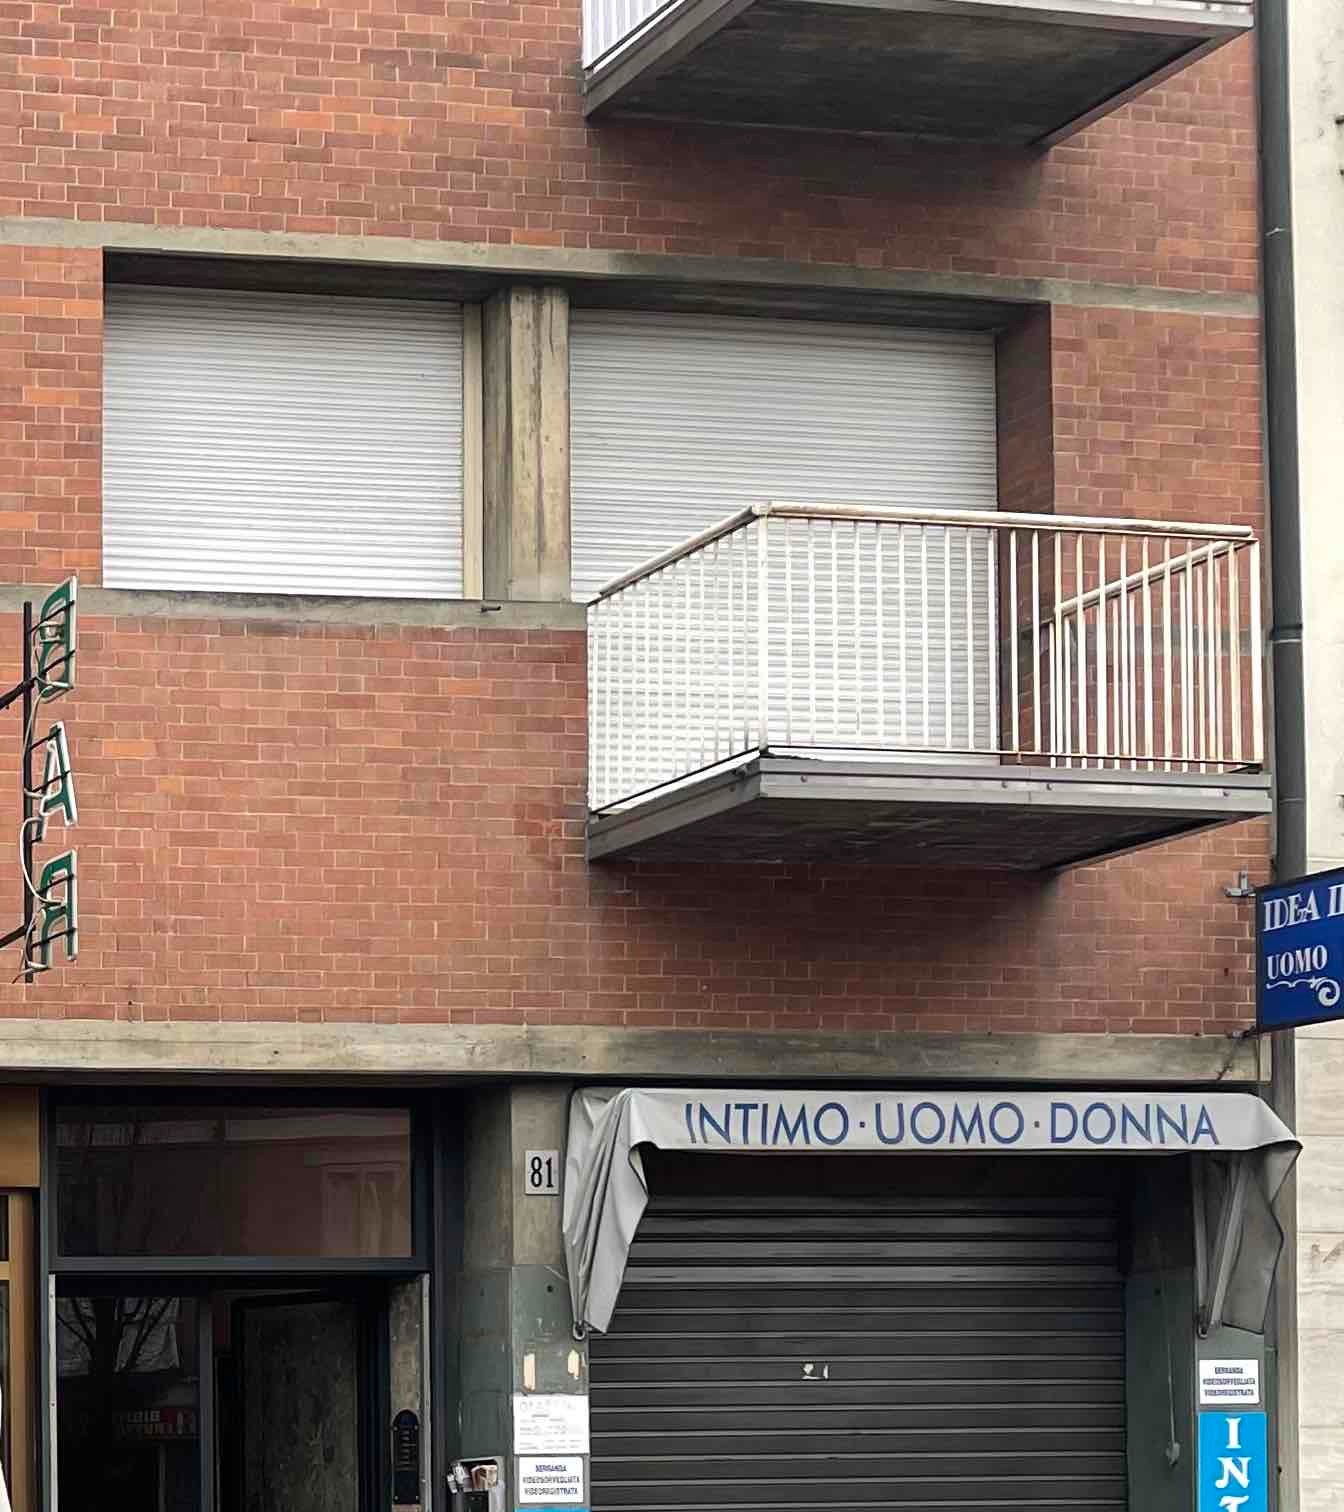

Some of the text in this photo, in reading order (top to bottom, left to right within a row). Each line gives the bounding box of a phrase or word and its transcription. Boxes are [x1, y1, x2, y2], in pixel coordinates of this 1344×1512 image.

[1263, 889, 1322, 932] IDEA
[1266, 944, 1328, 980] UOMO
[683, 1101, 1220, 1147] INTIMO UOMO DONNA
[528, 1156, 557, 1190] 81
